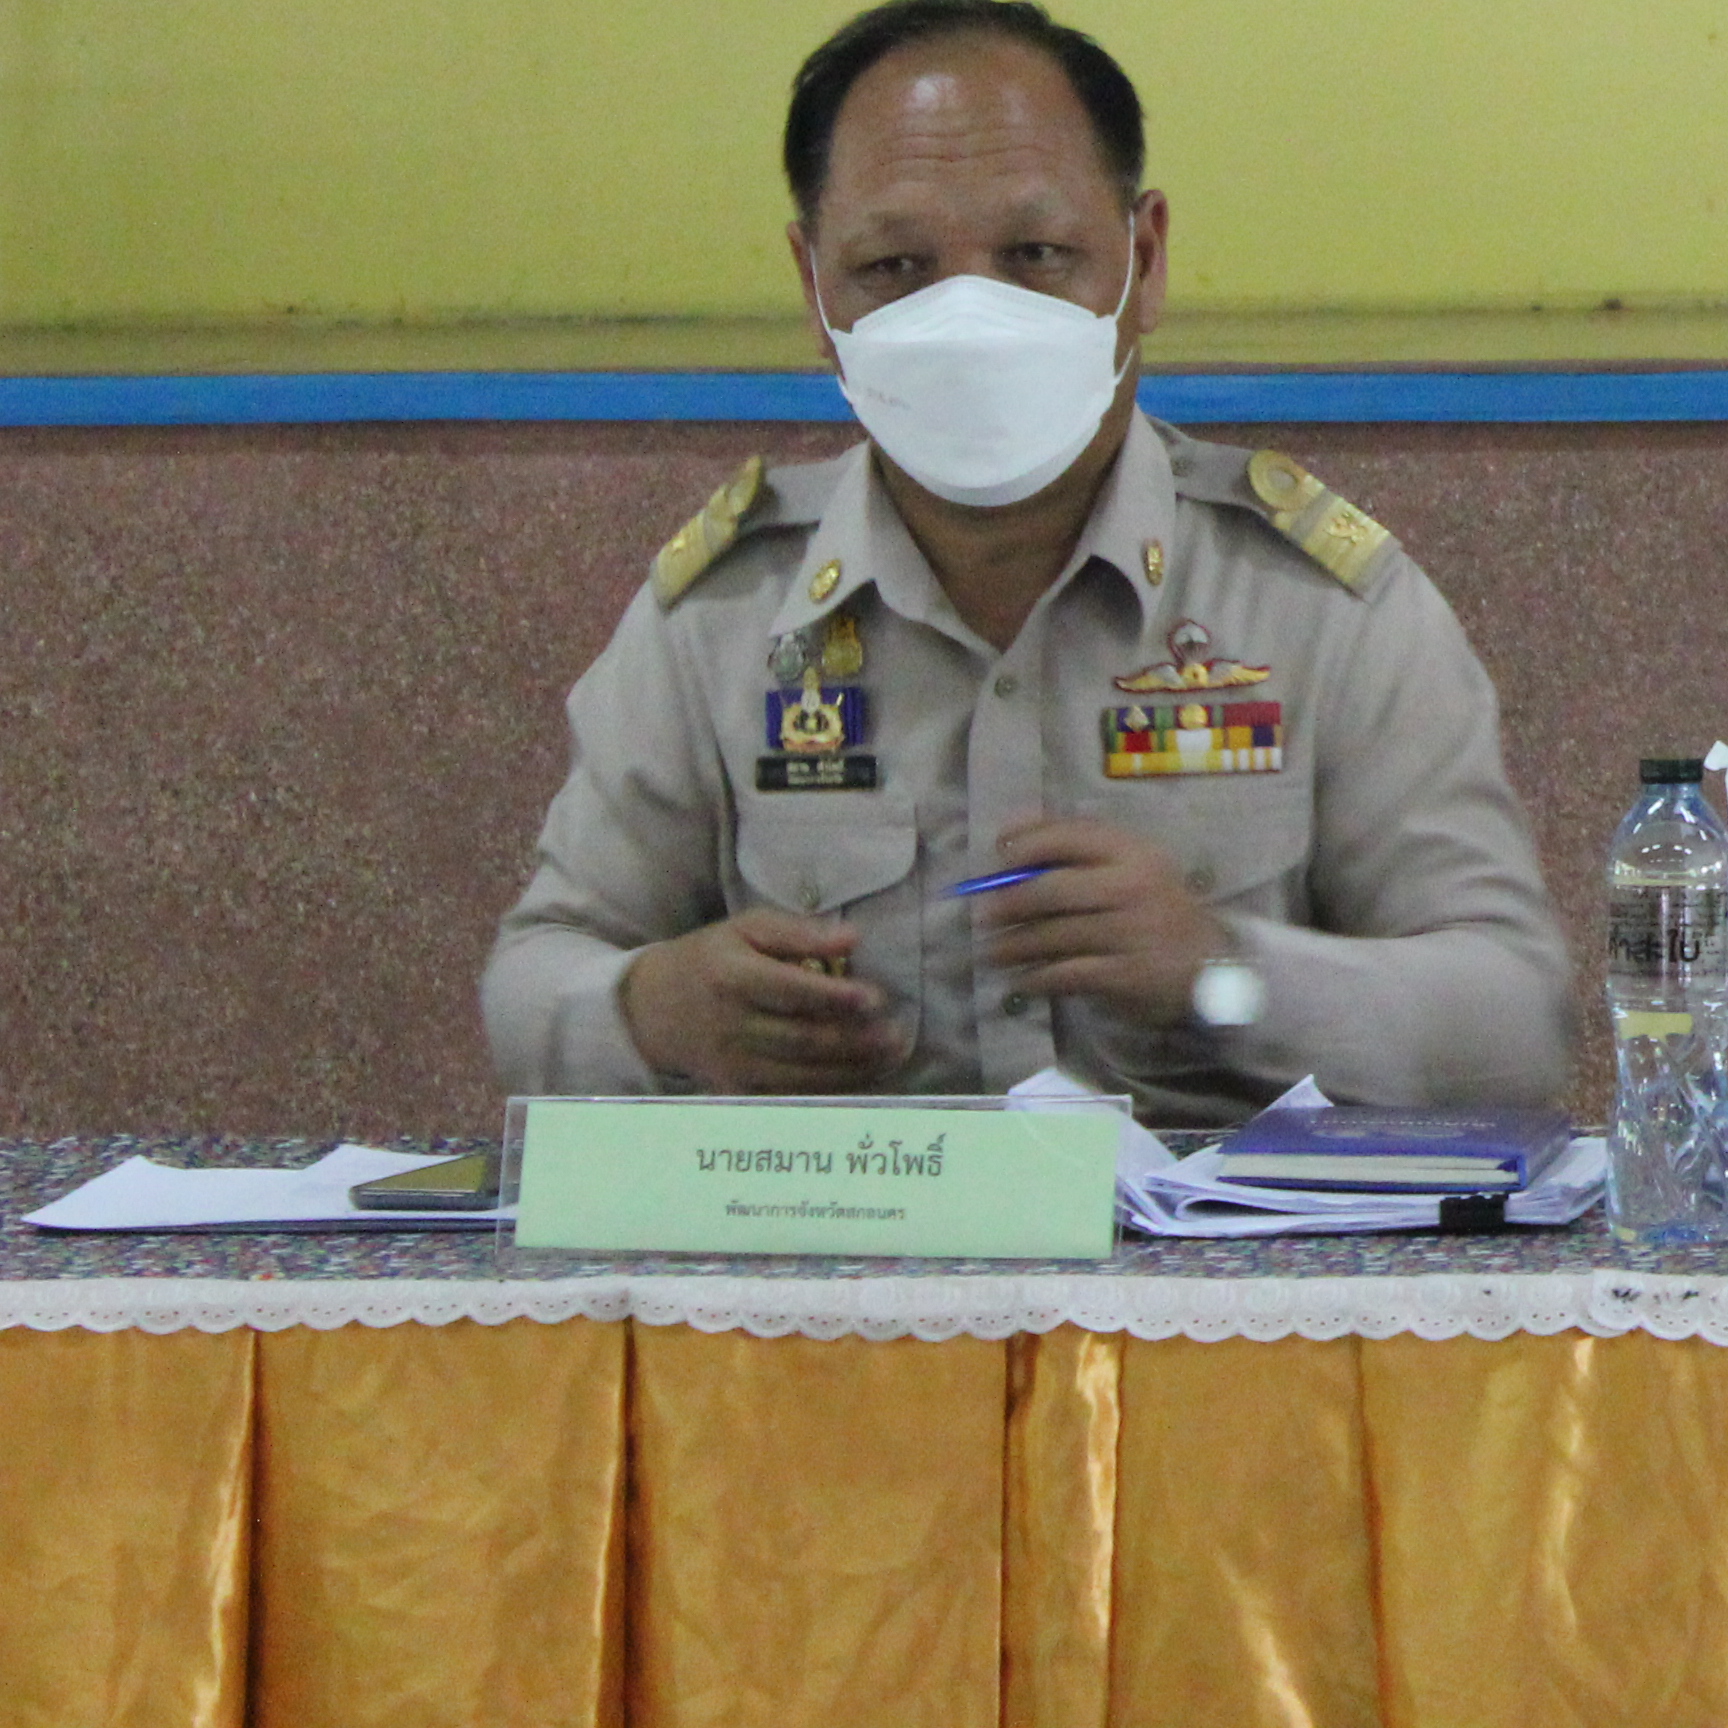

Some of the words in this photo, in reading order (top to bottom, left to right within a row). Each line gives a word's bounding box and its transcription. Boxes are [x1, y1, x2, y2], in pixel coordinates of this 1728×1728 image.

[697, 1148, 833, 1173] นายสมาน
[846, 1133, 947, 1177] พั่วโพธิ์
